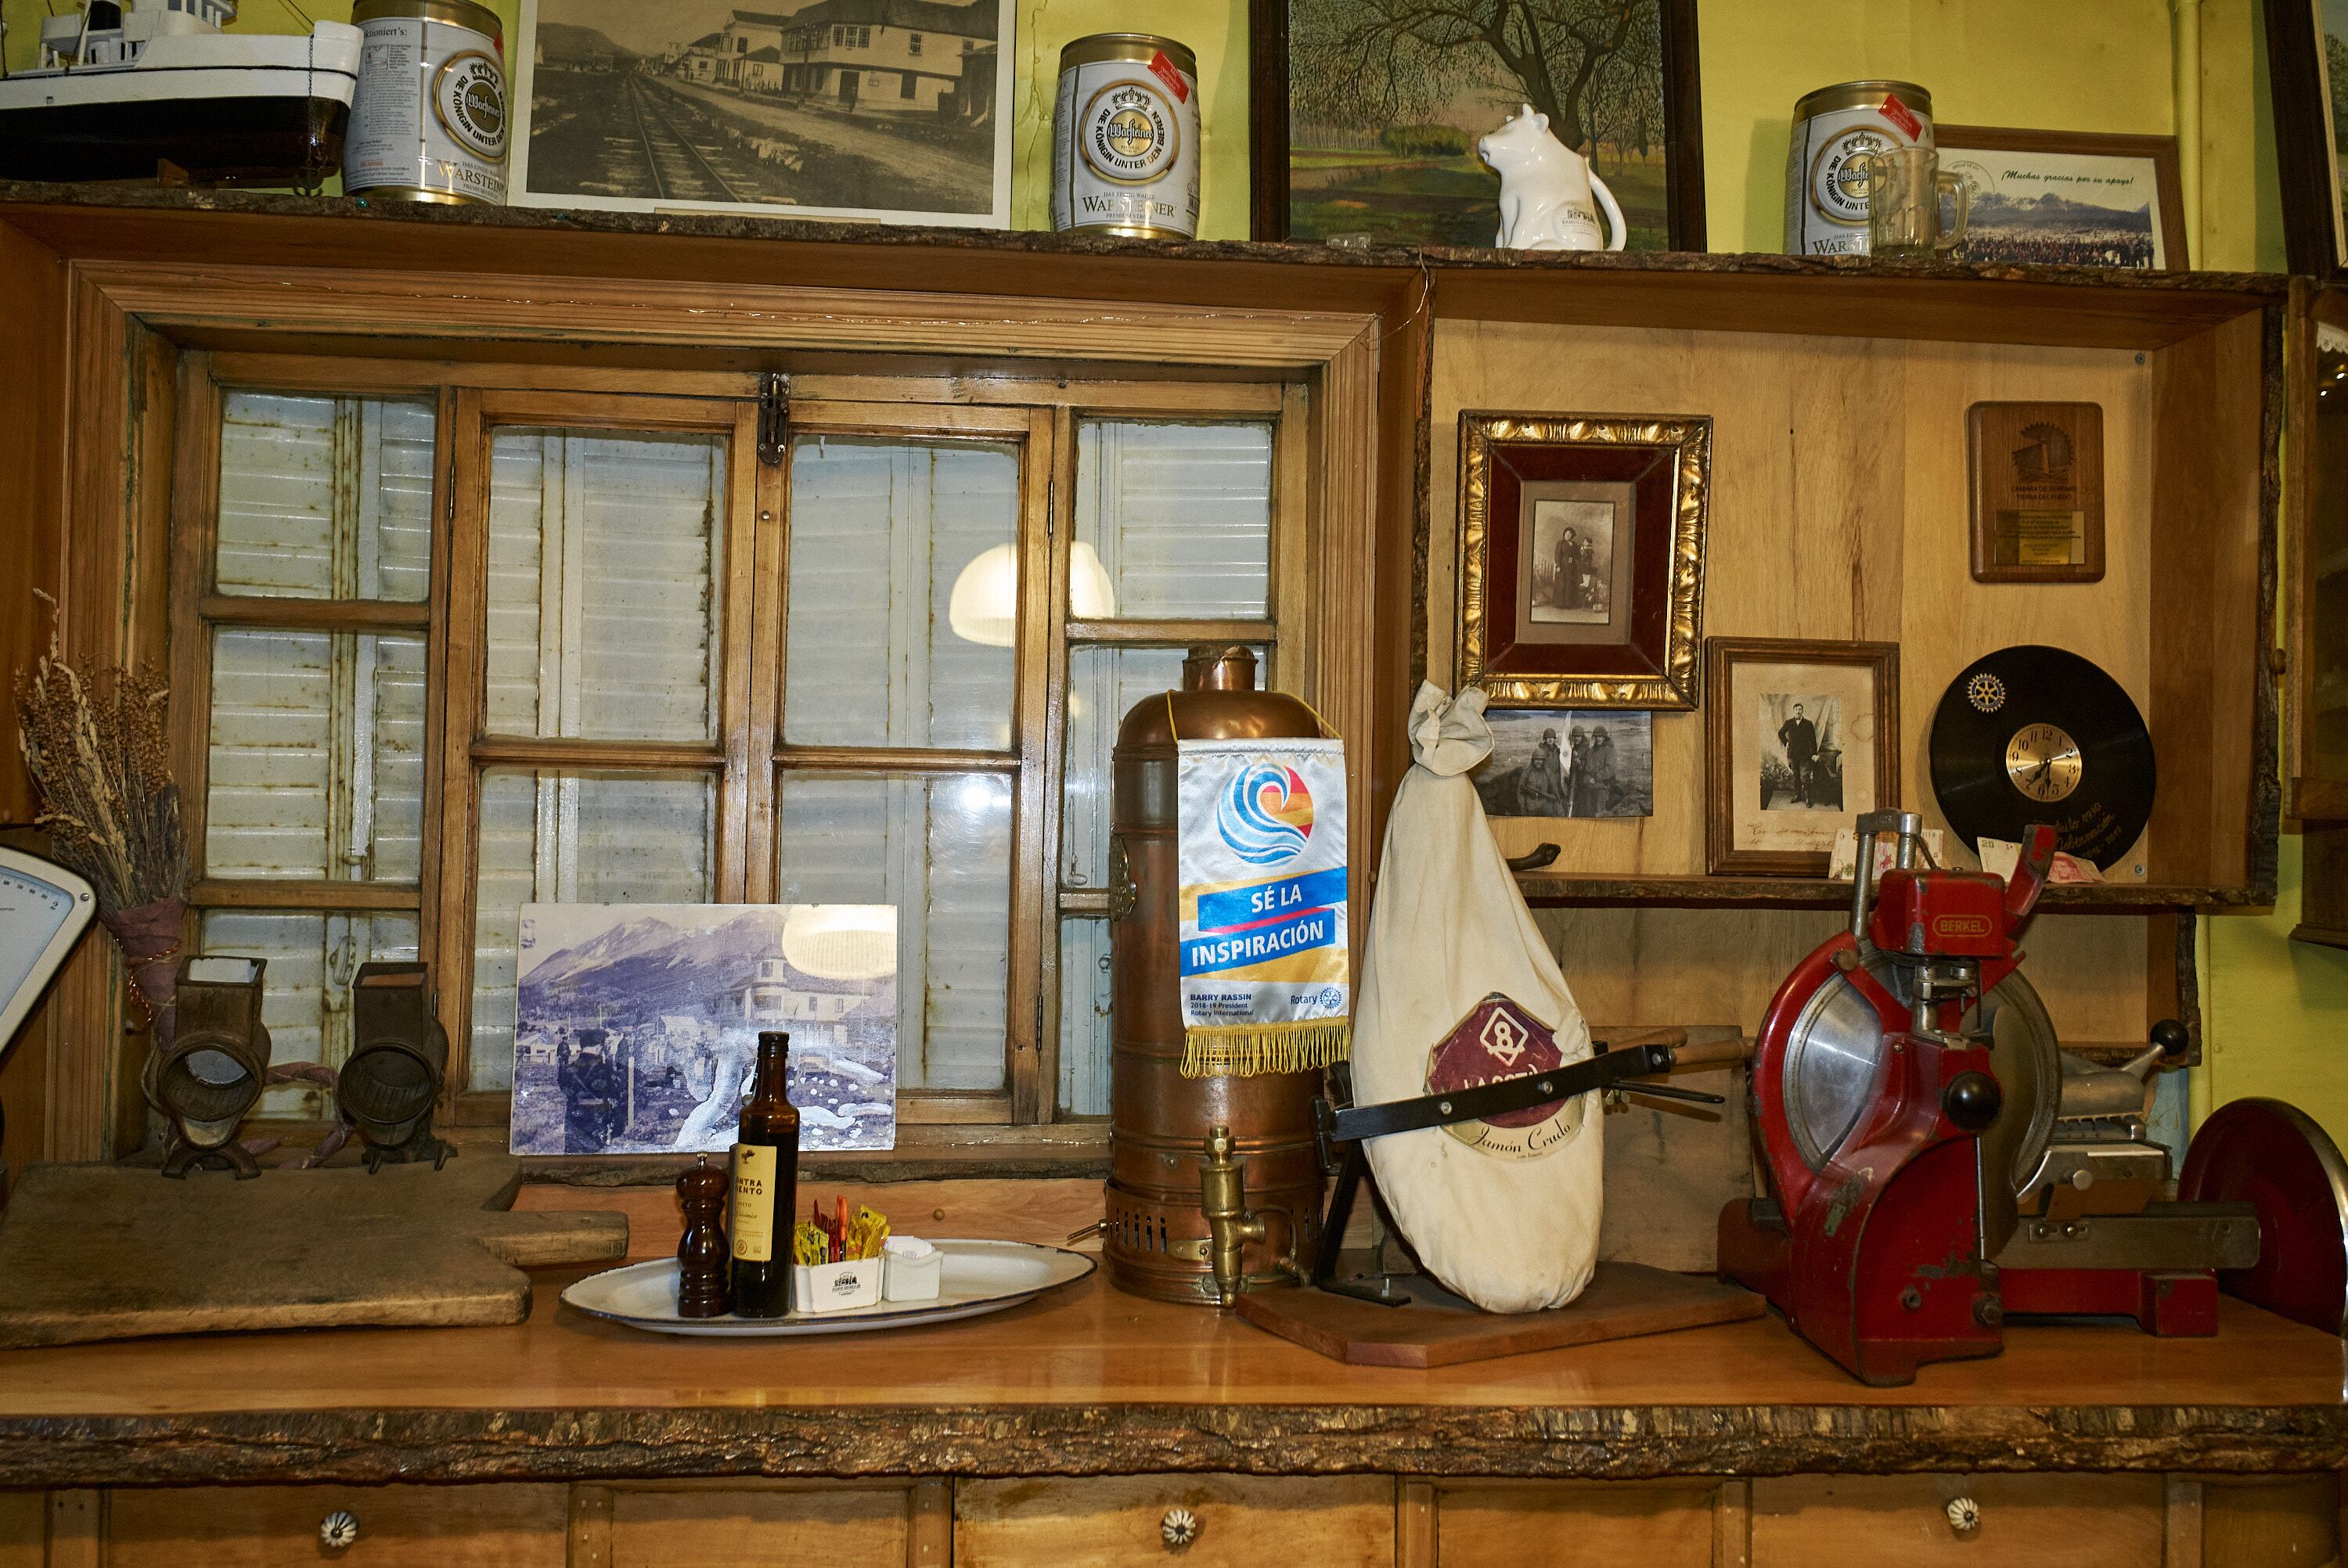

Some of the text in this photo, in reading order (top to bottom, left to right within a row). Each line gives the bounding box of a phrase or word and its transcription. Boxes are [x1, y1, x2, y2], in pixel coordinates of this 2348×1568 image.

[456, 75, 469, 92] DIE
[453, 90, 473, 132] KÖNIGIN
[1097, 108, 1111, 124] DIE
[473, 130, 497, 146] UNTER
[1096, 125, 1115, 163] KÖNIGIN
[1147, 146, 1162, 164] DEN
[1115, 158, 1147, 169] UNTER
[1829, 156, 1842, 171] DIE
[2044, 174, 2073, 184] gracias
[2076, 175, 2091, 184] por
[2105, 177, 2134, 185] apoyo!
[1826, 172, 1846, 206] KÖNIGIN
[1845, 200, 1869, 210] UNTE
[2043, 729, 2053, 740] 12
[2058, 735, 2062, 746] 1
[2018, 739, 2029, 751] 10
[2012, 751, 2019, 762] 9
[2066, 747, 2073, 758] 2
[2052, 784, 2060, 795] 5
[1982, 840, 1995, 848] 20
[1251, 883, 1302, 914] SÉ LA
[50, 901, 59, 910] 2
[1940, 919, 1985, 932] BERKEL
[1192, 919, 1323, 967] INSPIRACIÓN
[1291, 994, 1317, 1005] Rotary
[1469, 1118, 1571, 1153] Jamón Crudo
